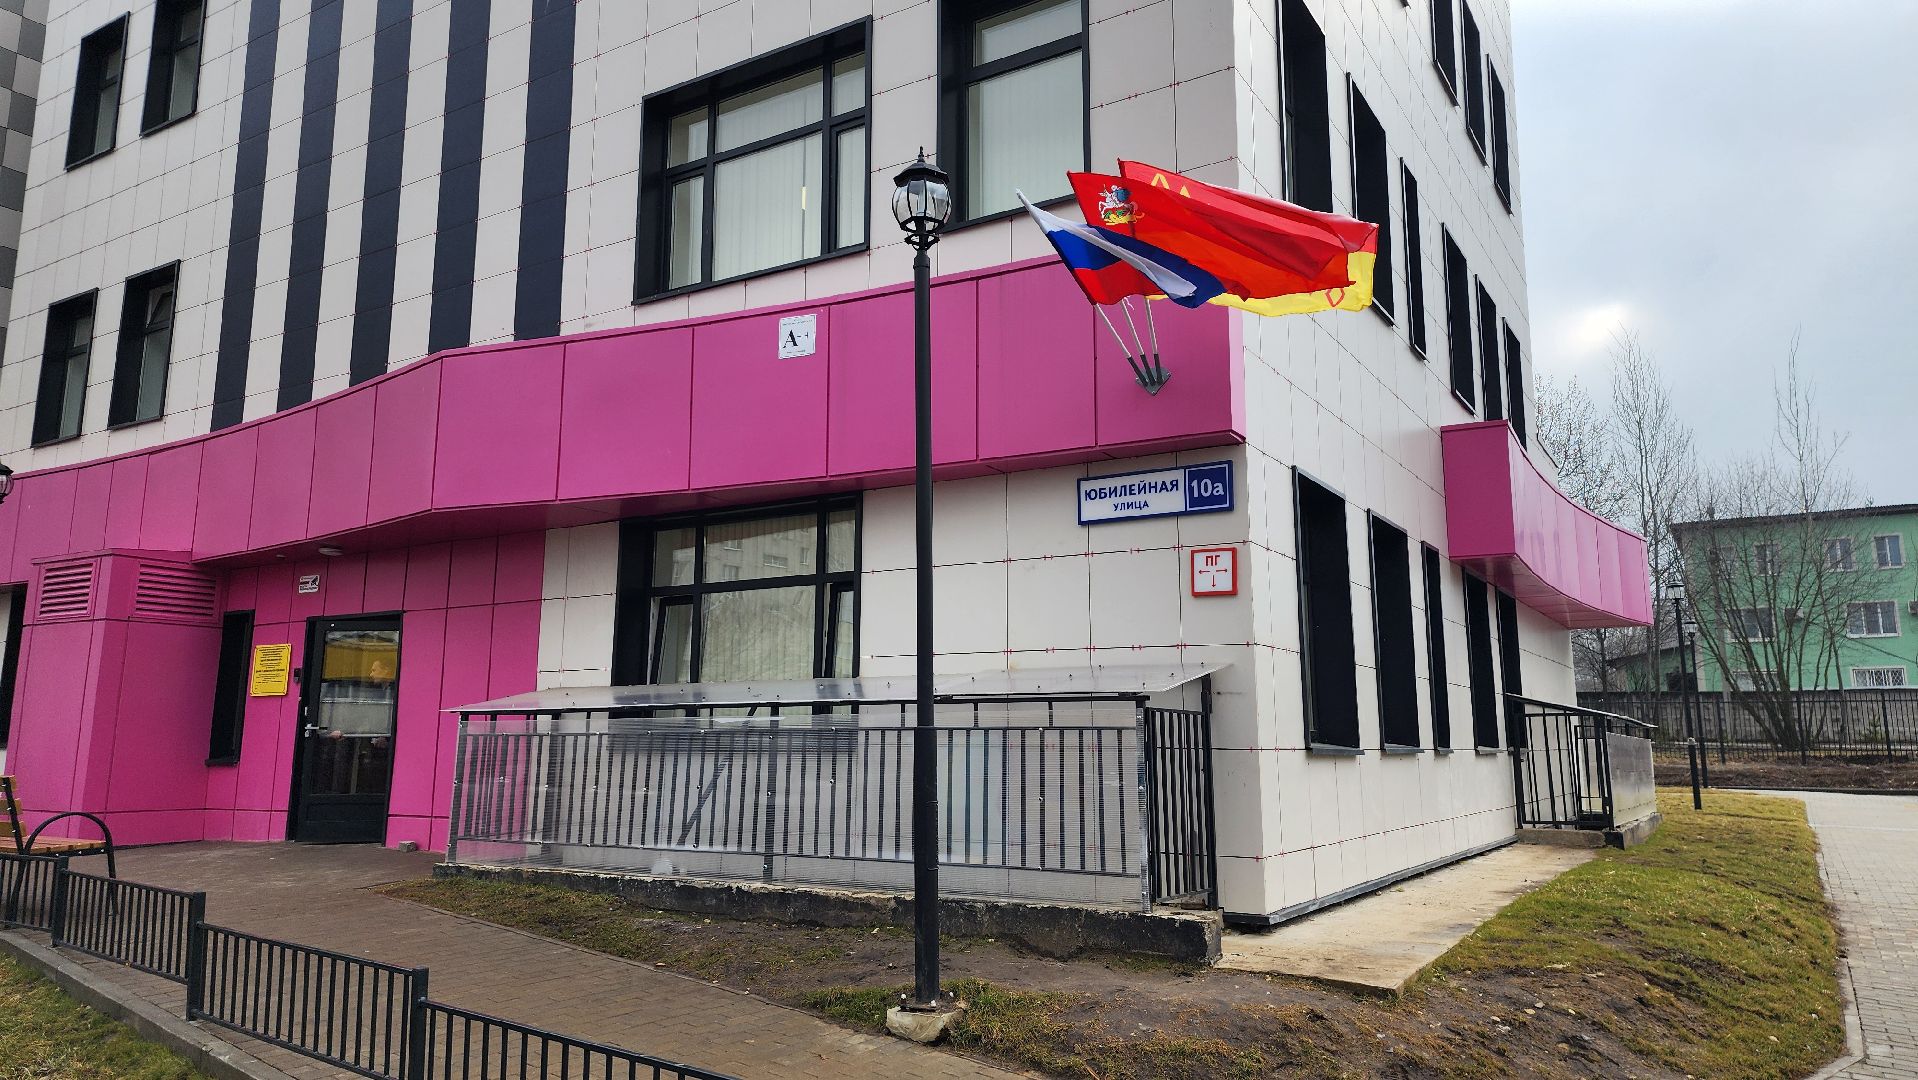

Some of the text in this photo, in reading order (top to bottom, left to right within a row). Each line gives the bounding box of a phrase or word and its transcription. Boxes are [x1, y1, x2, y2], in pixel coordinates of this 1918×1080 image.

[1084, 479, 1180, 501] ЮБИЛЕЙНАЯ
[1191, 478, 1225, 498] 10а
[1113, 500, 1150, 511] УЛИЦА
[1205, 555, 1221, 566] ПГ
